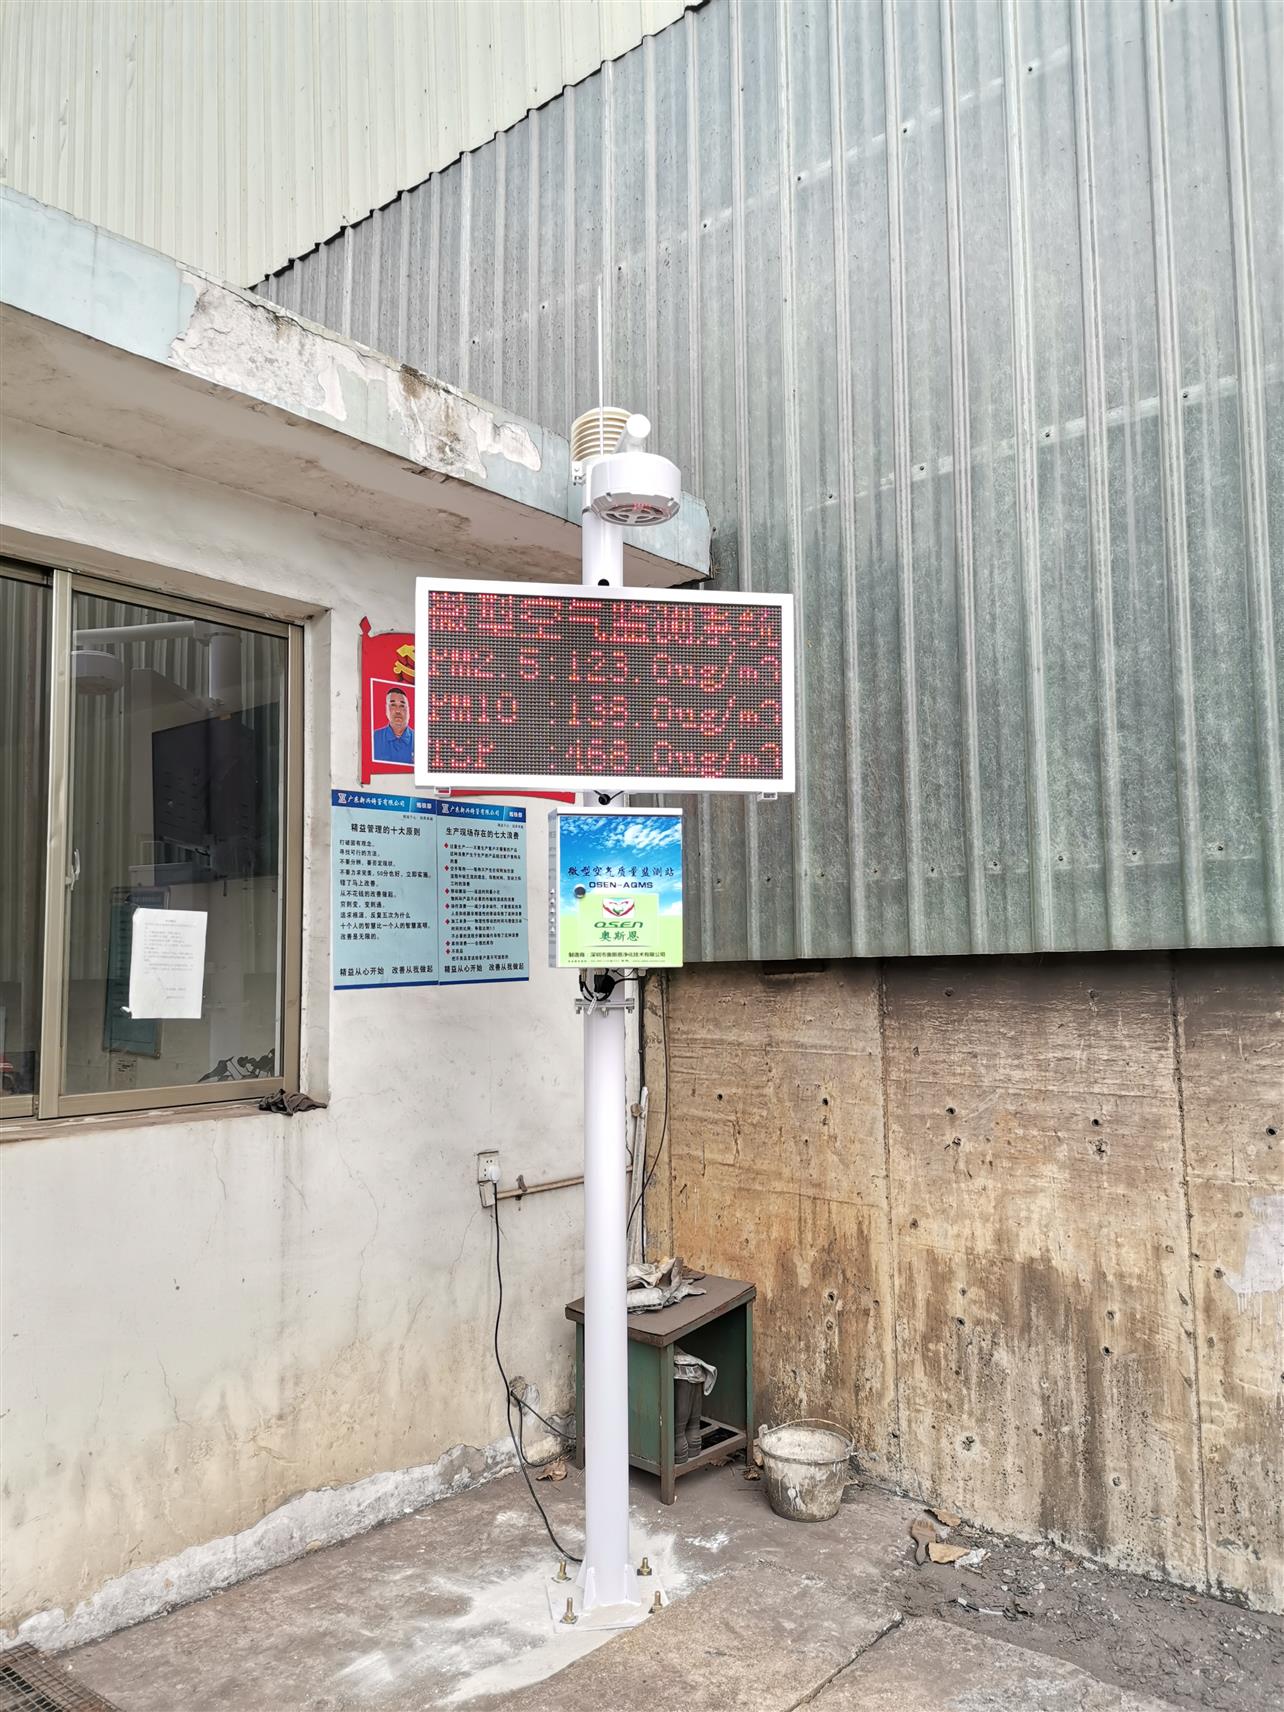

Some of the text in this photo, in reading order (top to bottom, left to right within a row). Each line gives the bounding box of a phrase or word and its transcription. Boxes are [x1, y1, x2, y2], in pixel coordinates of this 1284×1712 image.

[351, 823, 421, 837] 精益管理的十大原则
[446, 827, 519, 840] 生产现场存在的七大浪费
[568, 865, 675, 878] 微型空气质量监测站
[588, 881, 654, 889] OSEN-AQMS
[599, 930, 640, 942] 奥斯恩
[339, 965, 433, 977] 精益从心开始 改善从我做起
[444, 962, 524, 974] 精益从心开始 改善从我做起
